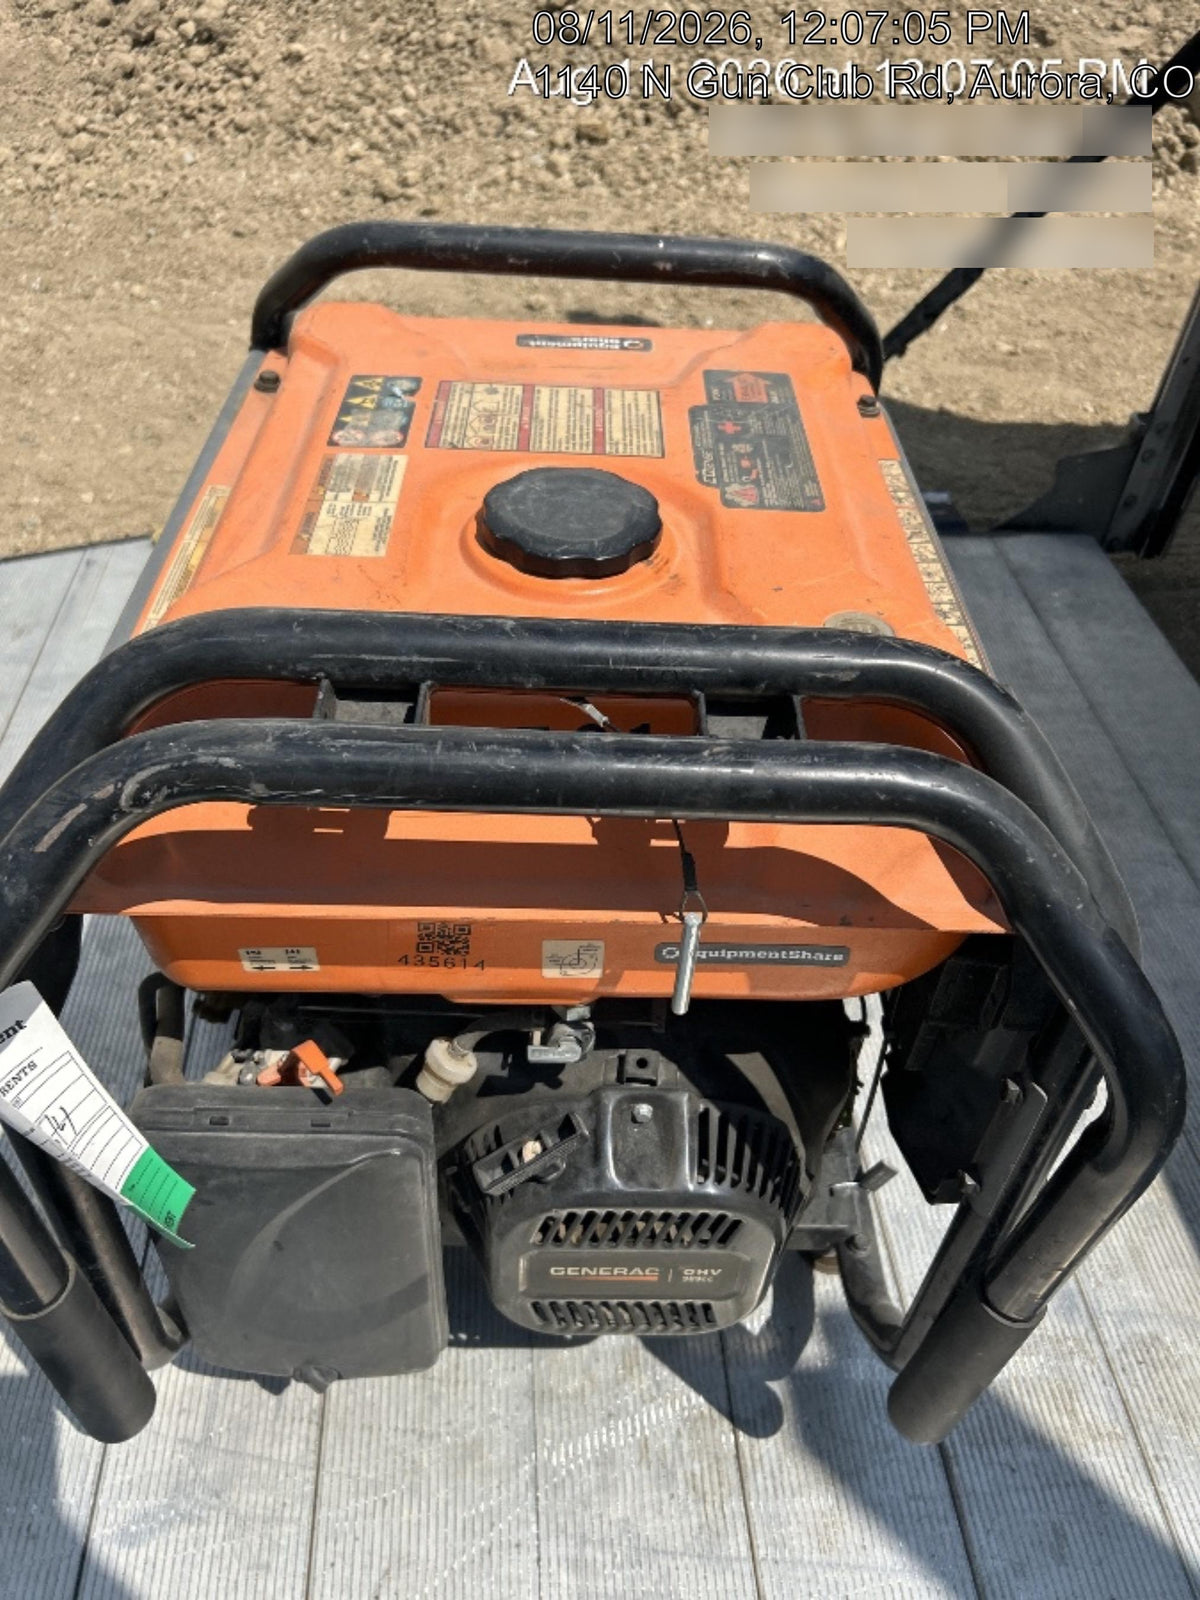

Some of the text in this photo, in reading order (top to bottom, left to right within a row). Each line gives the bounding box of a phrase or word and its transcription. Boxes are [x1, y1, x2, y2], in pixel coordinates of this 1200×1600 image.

[690, 949, 844, 961] quipmentShare
[397, 954, 485, 971] 435614
[550, 1266, 722, 1276] GENERAC OHV
